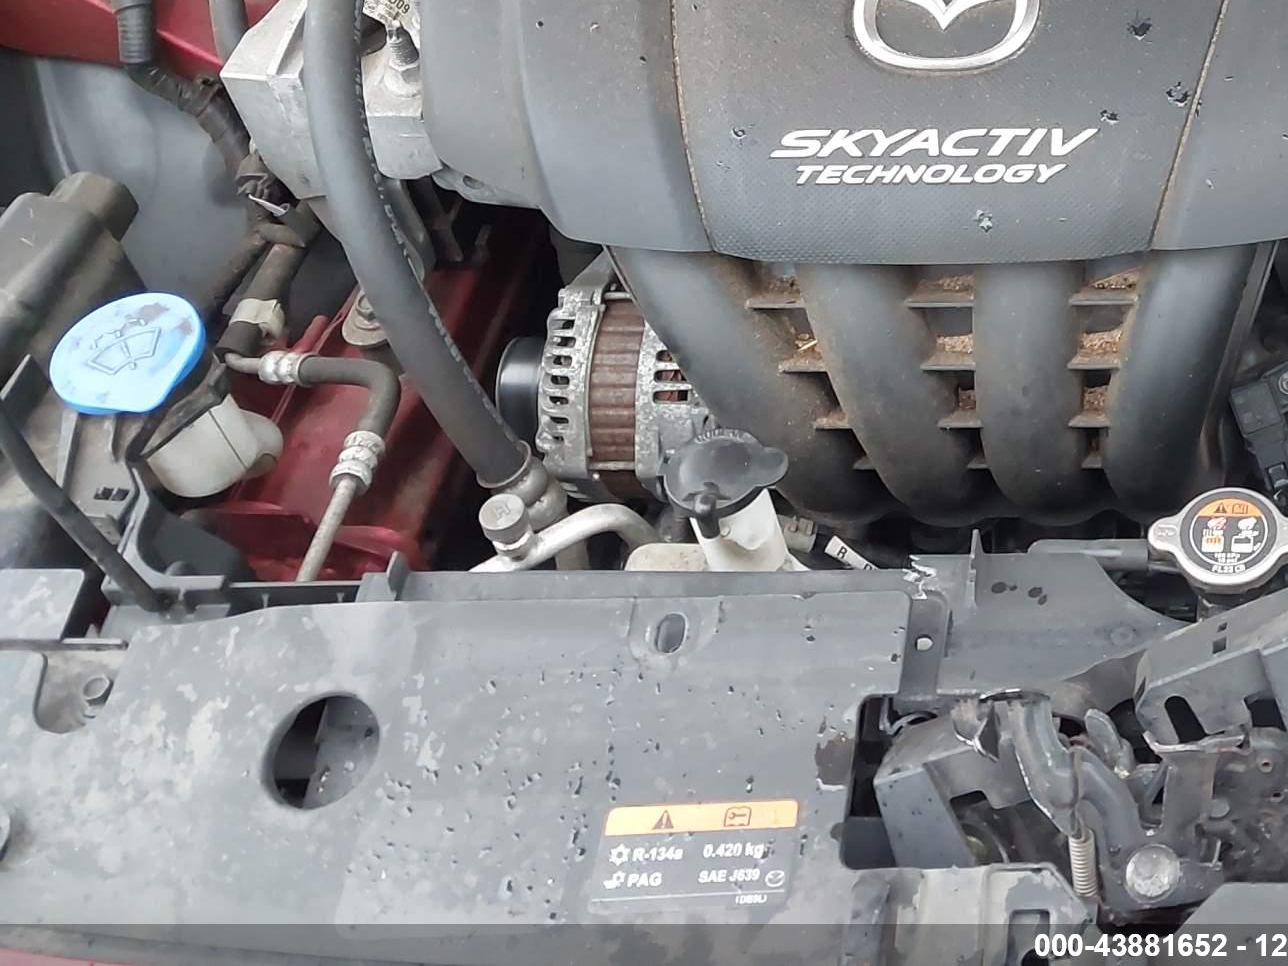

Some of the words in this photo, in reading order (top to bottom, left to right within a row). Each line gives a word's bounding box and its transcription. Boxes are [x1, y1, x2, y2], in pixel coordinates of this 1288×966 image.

[770, 128, 1099, 158] SKYACTIV
[796, 164, 1068, 185] TECHNOLOGY
[633, 846, 683, 862] R-134a
[703, 843, 742, 858] 0.420
[744, 842, 765, 859] kg
[627, 872, 663, 888] PAG
[698, 870, 727, 884] SAE
[728, 868, 760, 883] J639
